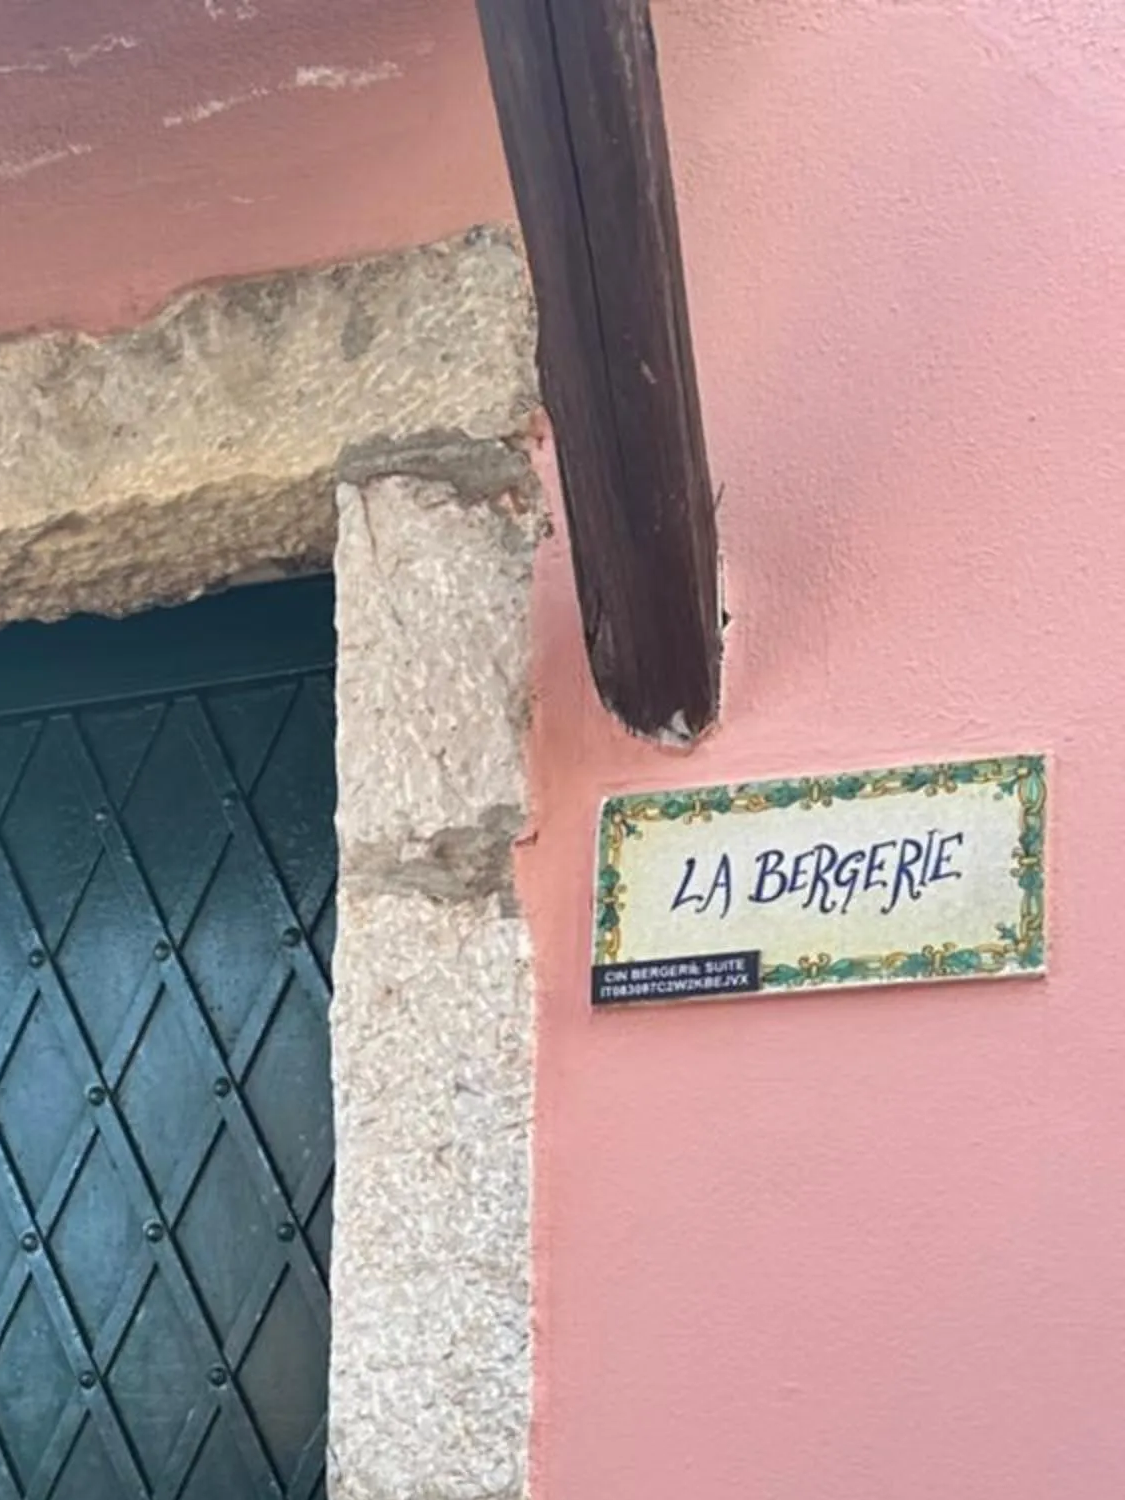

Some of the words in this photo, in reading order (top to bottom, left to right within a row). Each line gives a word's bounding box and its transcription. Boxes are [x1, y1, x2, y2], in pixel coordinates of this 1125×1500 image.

[671, 852, 732, 918] LA
[748, 829, 964, 914] BERGERIE
[604, 969, 628, 983] CIN
[704, 957, 746, 974] SUITE
